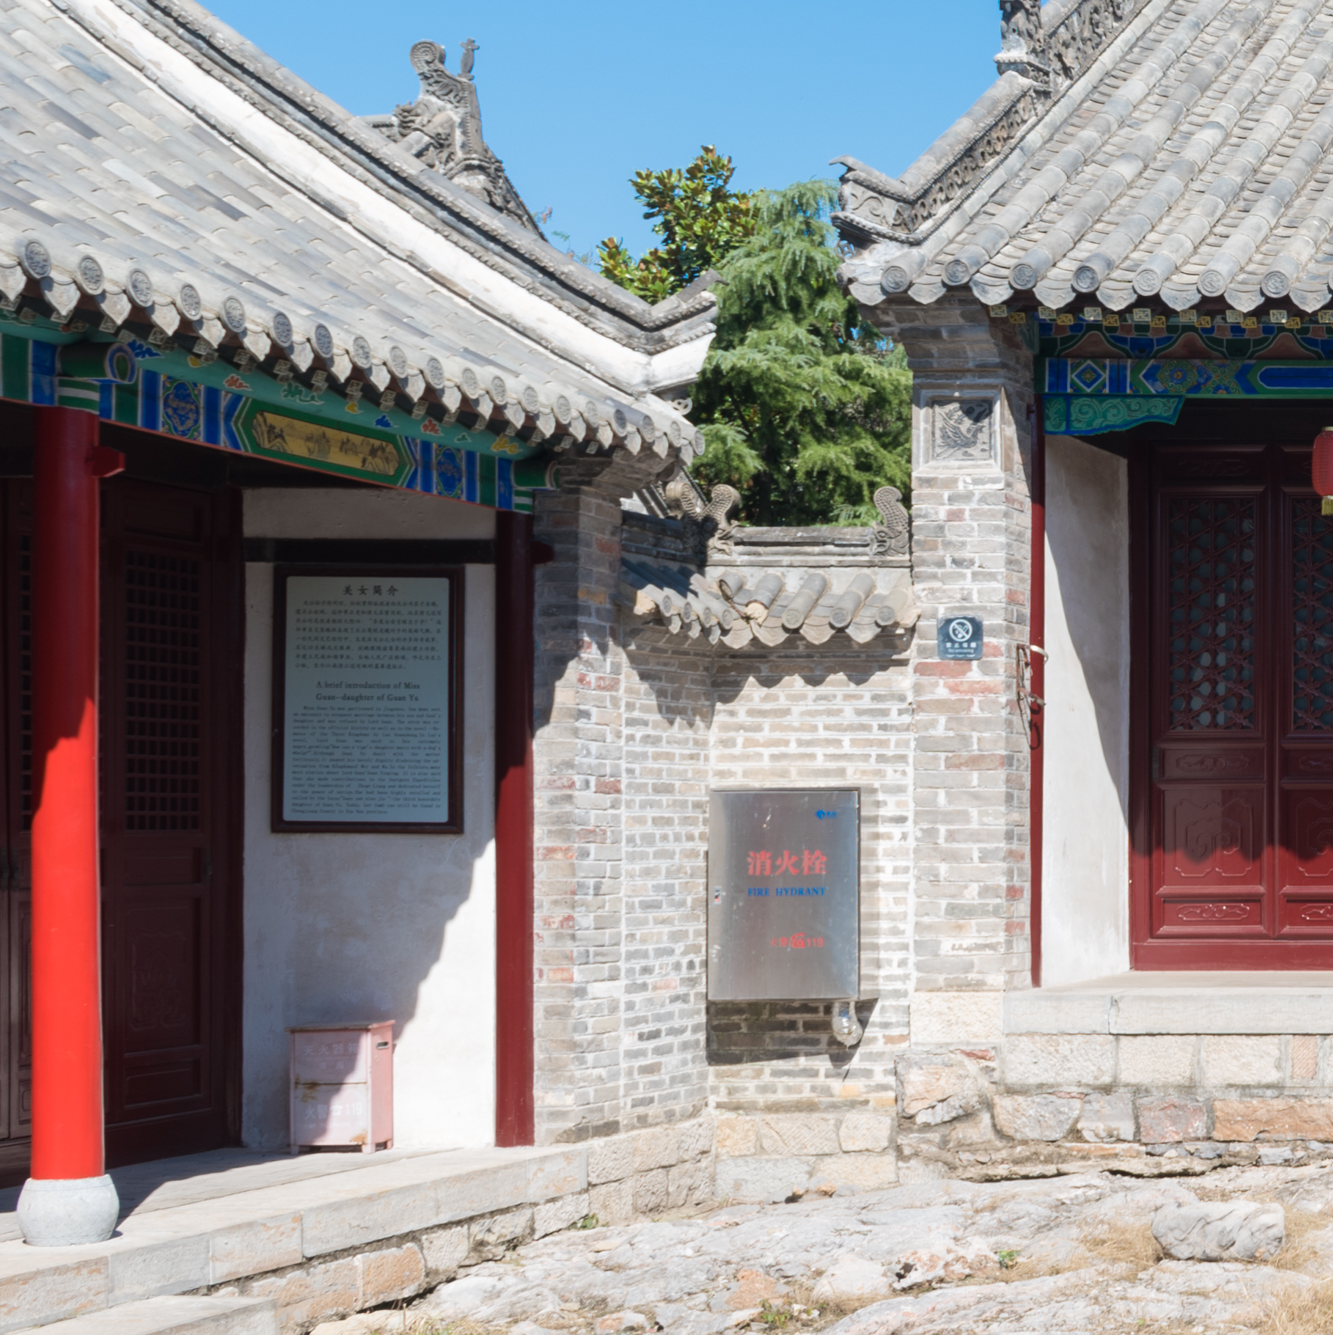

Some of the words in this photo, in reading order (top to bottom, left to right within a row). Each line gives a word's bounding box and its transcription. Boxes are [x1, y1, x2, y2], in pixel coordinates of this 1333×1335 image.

[316, 681, 322, 689] A
[324, 681, 343, 689] brief
[344, 681, 391, 690] introduction
[393, 682, 402, 690] of
[403, 682, 420, 690] Miss
[376, 693, 386, 701] of
[387, 693, 407, 702] Guan
[408, 694, 419, 702] Yu
[746, 850, 828, 876] 消火栓
[748, 887, 770, 897] FIRE
[776, 886, 827, 896] HYDRANT
[807, 937, 824, 948] 119
[344, 1102, 363, 1116] 119
